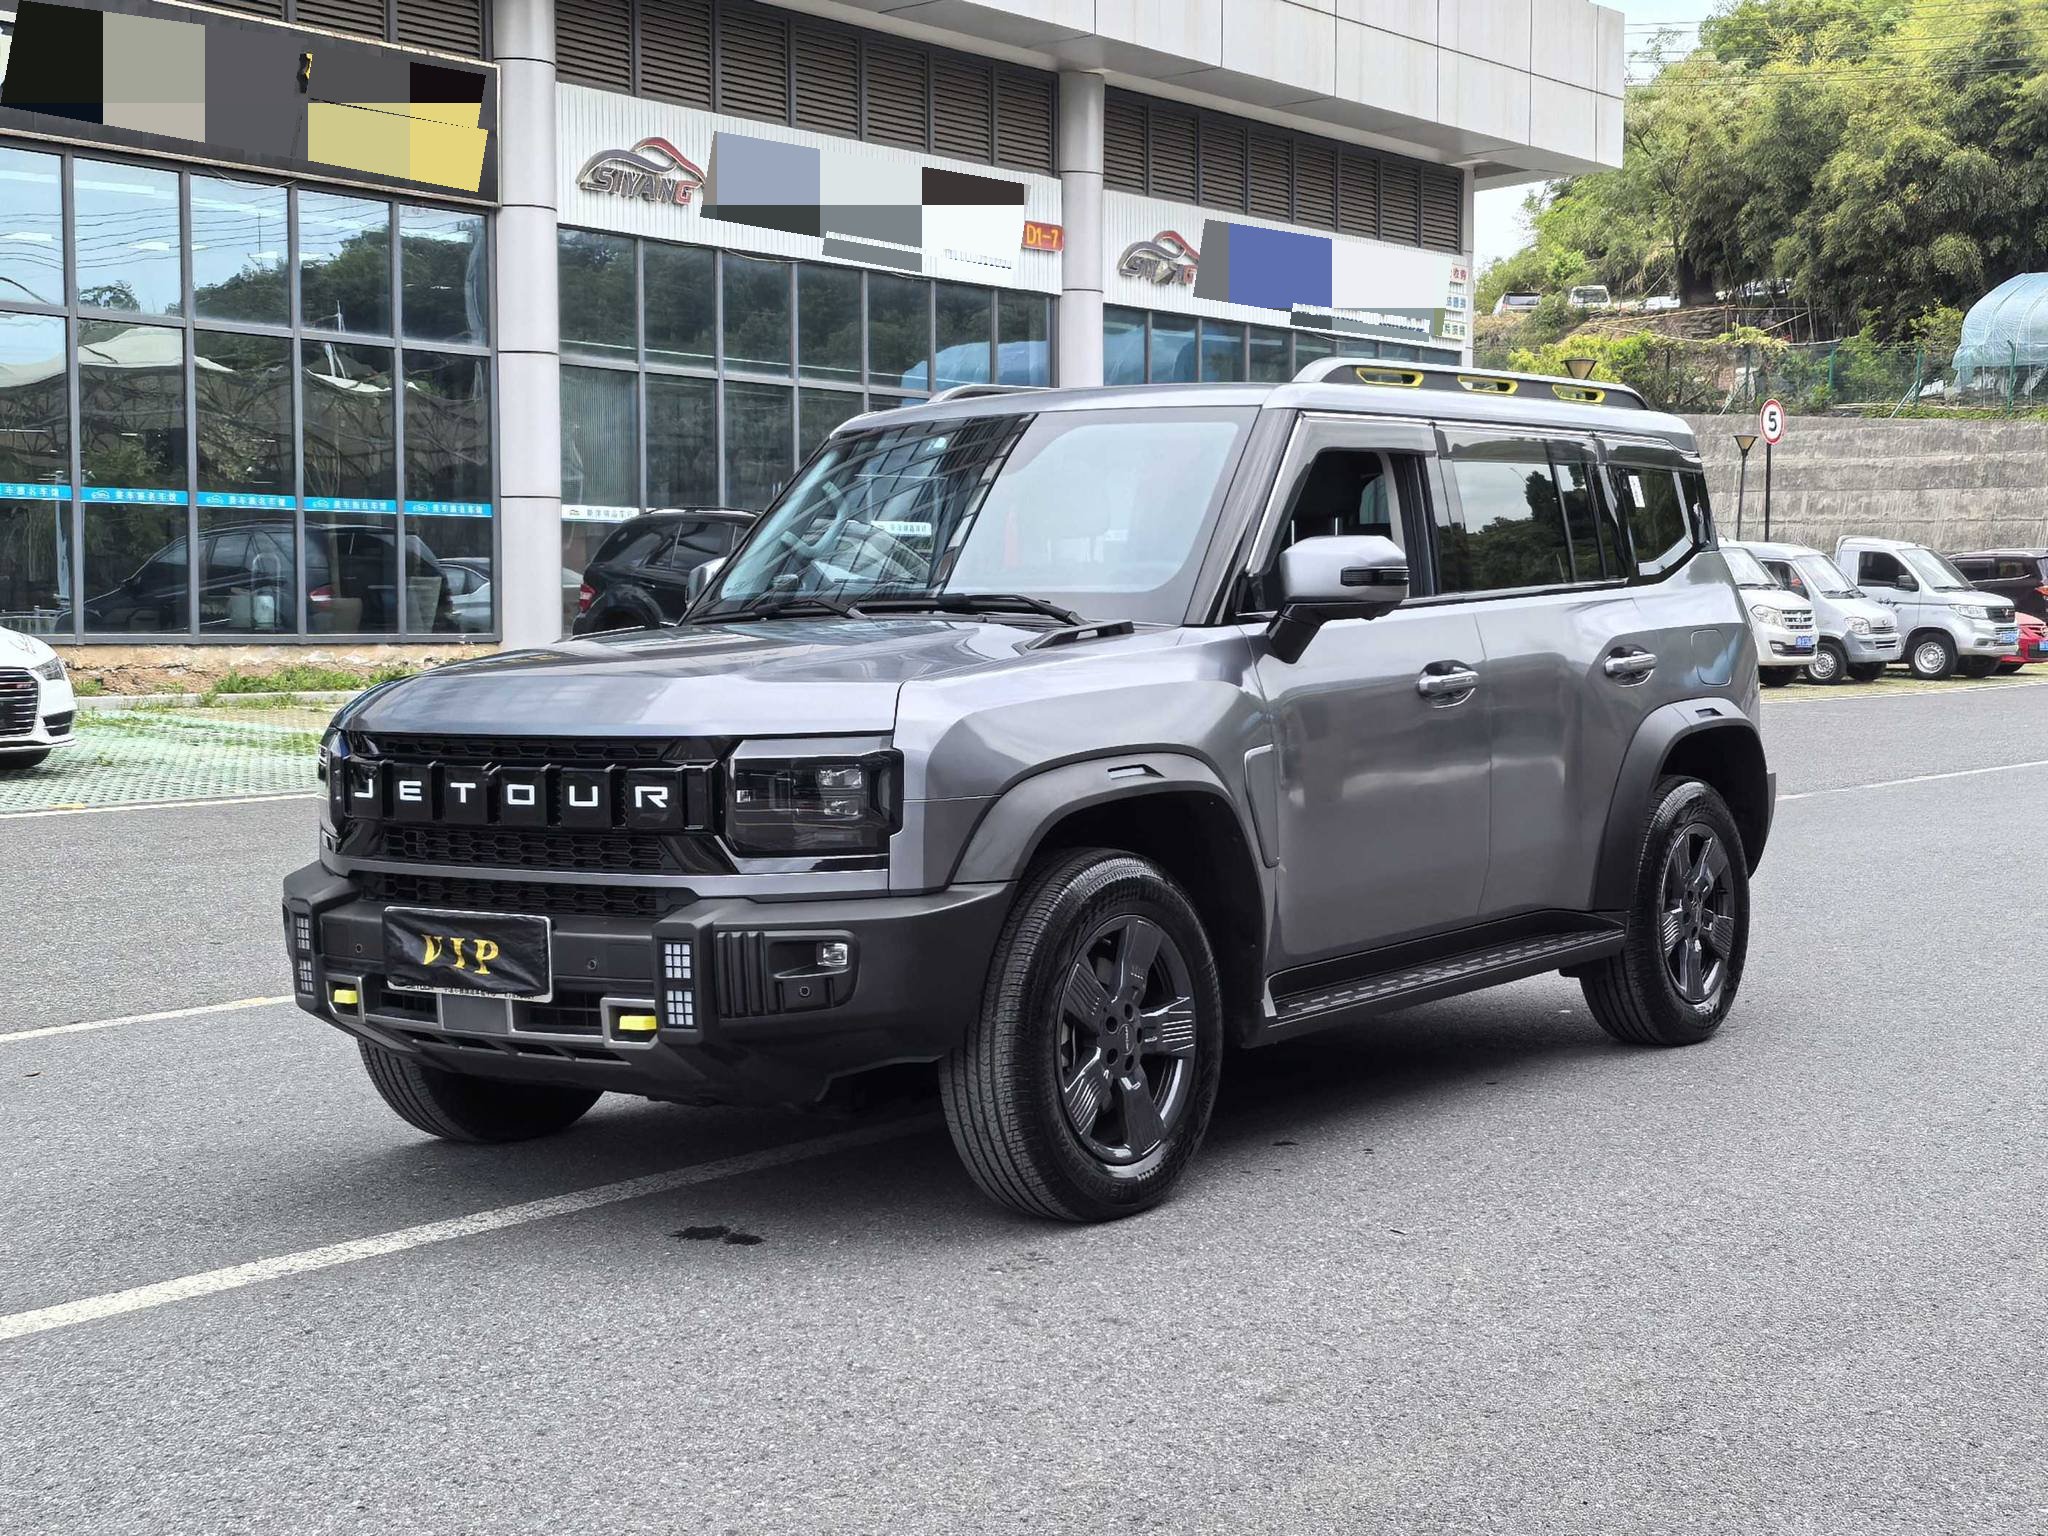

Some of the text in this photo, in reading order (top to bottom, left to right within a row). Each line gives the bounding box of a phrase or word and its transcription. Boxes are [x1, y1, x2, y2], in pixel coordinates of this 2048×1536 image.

[580, 165, 702, 205] SIYANG
[1026, 223, 1059, 248] D1-7
[1768, 411, 1777, 432] 5
[353, 778, 669, 808] JETOUR
[421, 934, 500, 975] VIP
